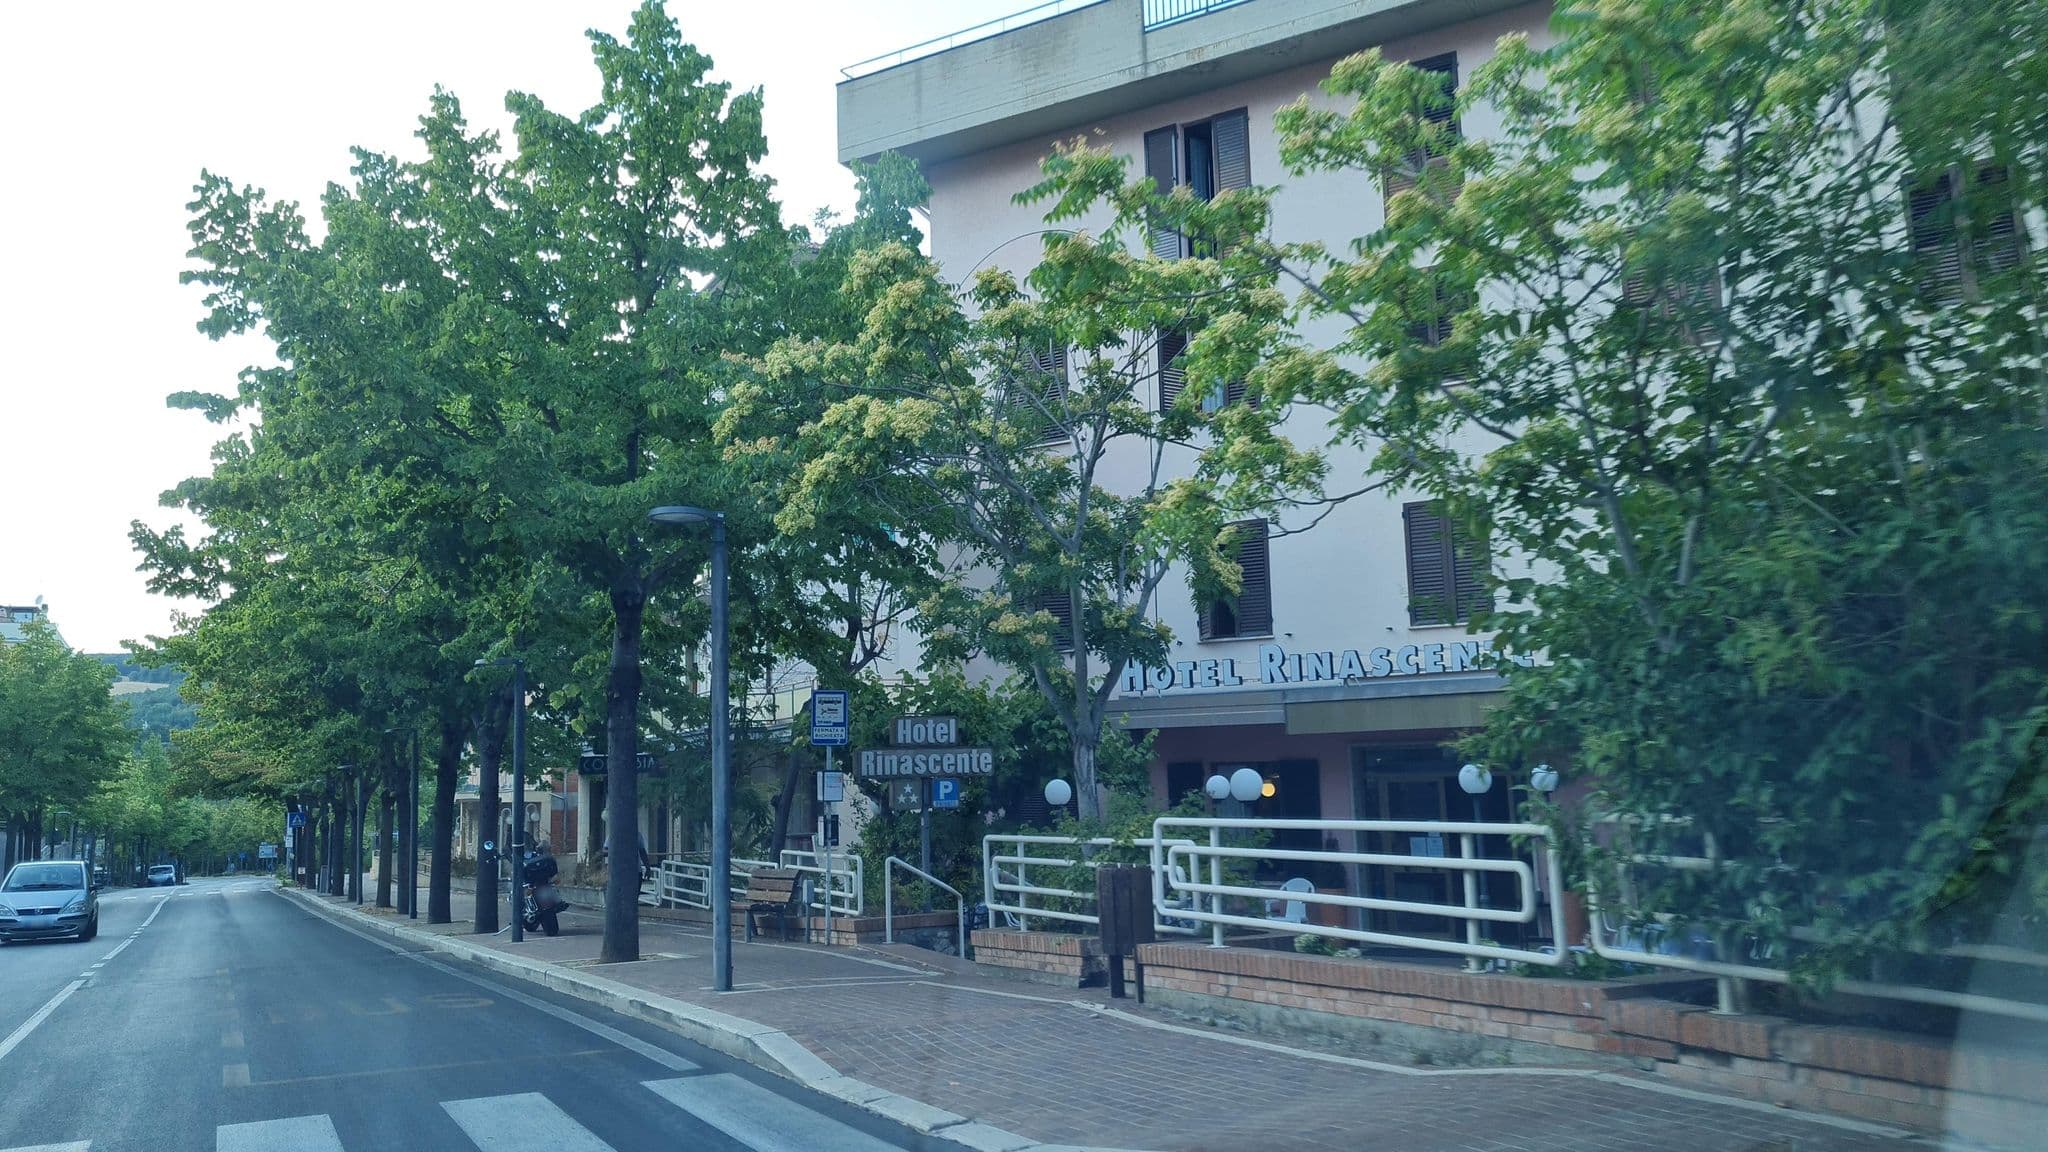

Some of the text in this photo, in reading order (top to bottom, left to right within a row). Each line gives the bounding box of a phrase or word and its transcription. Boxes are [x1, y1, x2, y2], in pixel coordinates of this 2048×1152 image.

[1120, 640, 1535, 692] HOTEL RINASCEN
[897, 718, 956, 744] Hotel
[861, 748, 993, 776] Rinascente
[939, 780, 953, 800] P
